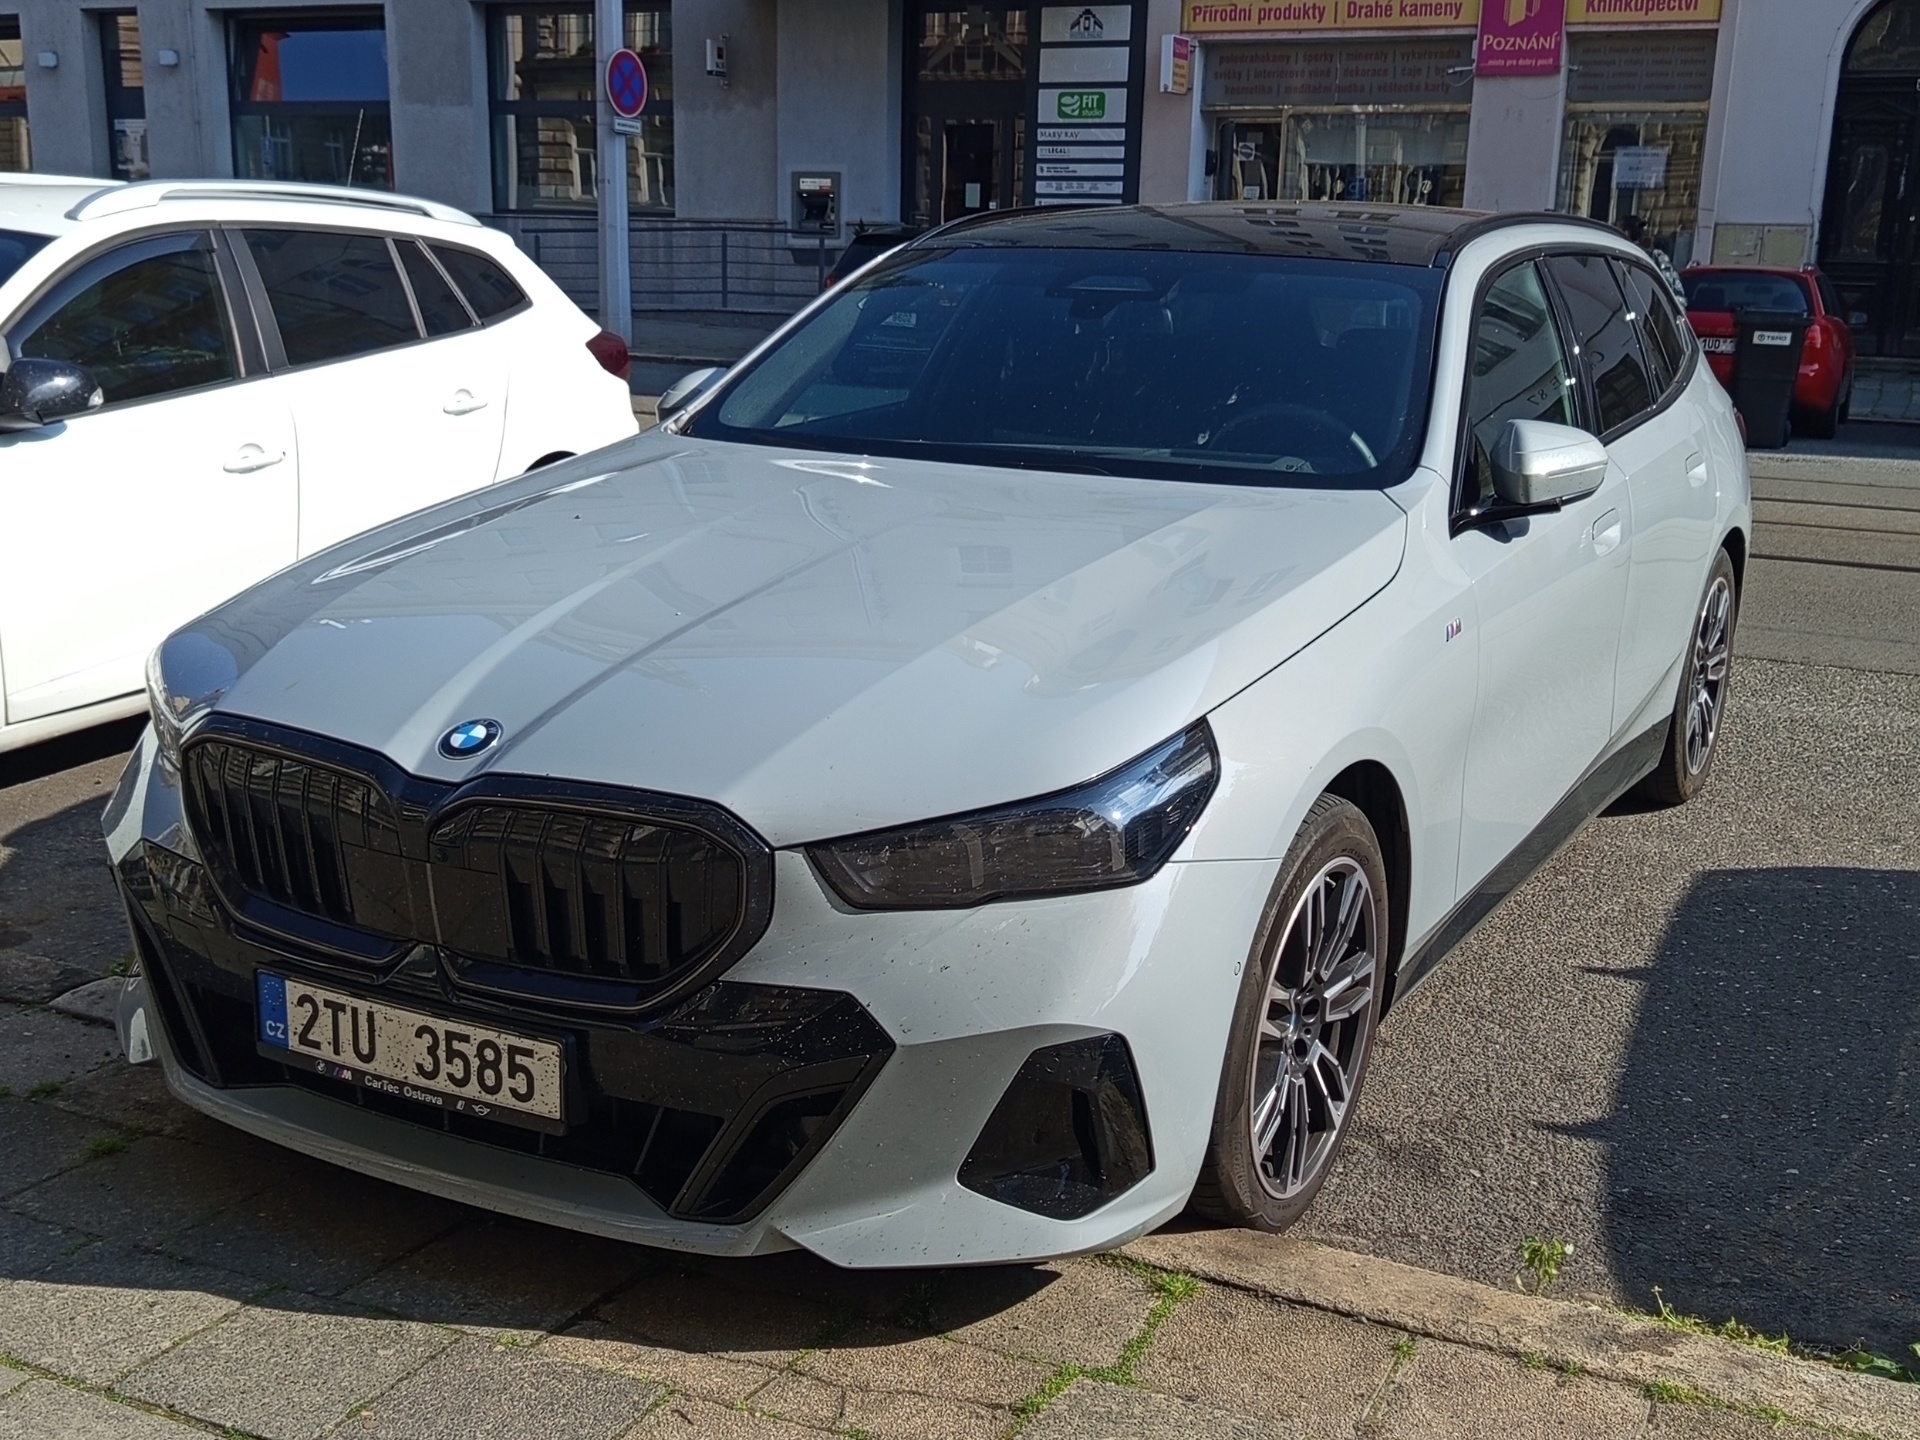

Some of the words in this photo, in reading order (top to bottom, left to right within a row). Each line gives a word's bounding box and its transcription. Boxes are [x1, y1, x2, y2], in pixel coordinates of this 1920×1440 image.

[1191, 4, 1253, 22] Přírodní
[1257, 2, 1326, 25] produkty
[1346, 0, 1393, 18] Drahé
[1398, 0, 1463, 20] kameny
[1082, 95, 1099, 108] FIT
[1081, 108, 1102, 116] studio
[1040, 131, 1063, 139] MARY
[1064, 130, 1080, 138] KAY
[265, 1020, 286, 1039] CZ
[296, 993, 376, 1064] 2TU
[414, 1024, 535, 1103] 3585
[364, 1075, 400, 1095] CarTec
[403, 1086, 443, 1105] Ostrava
